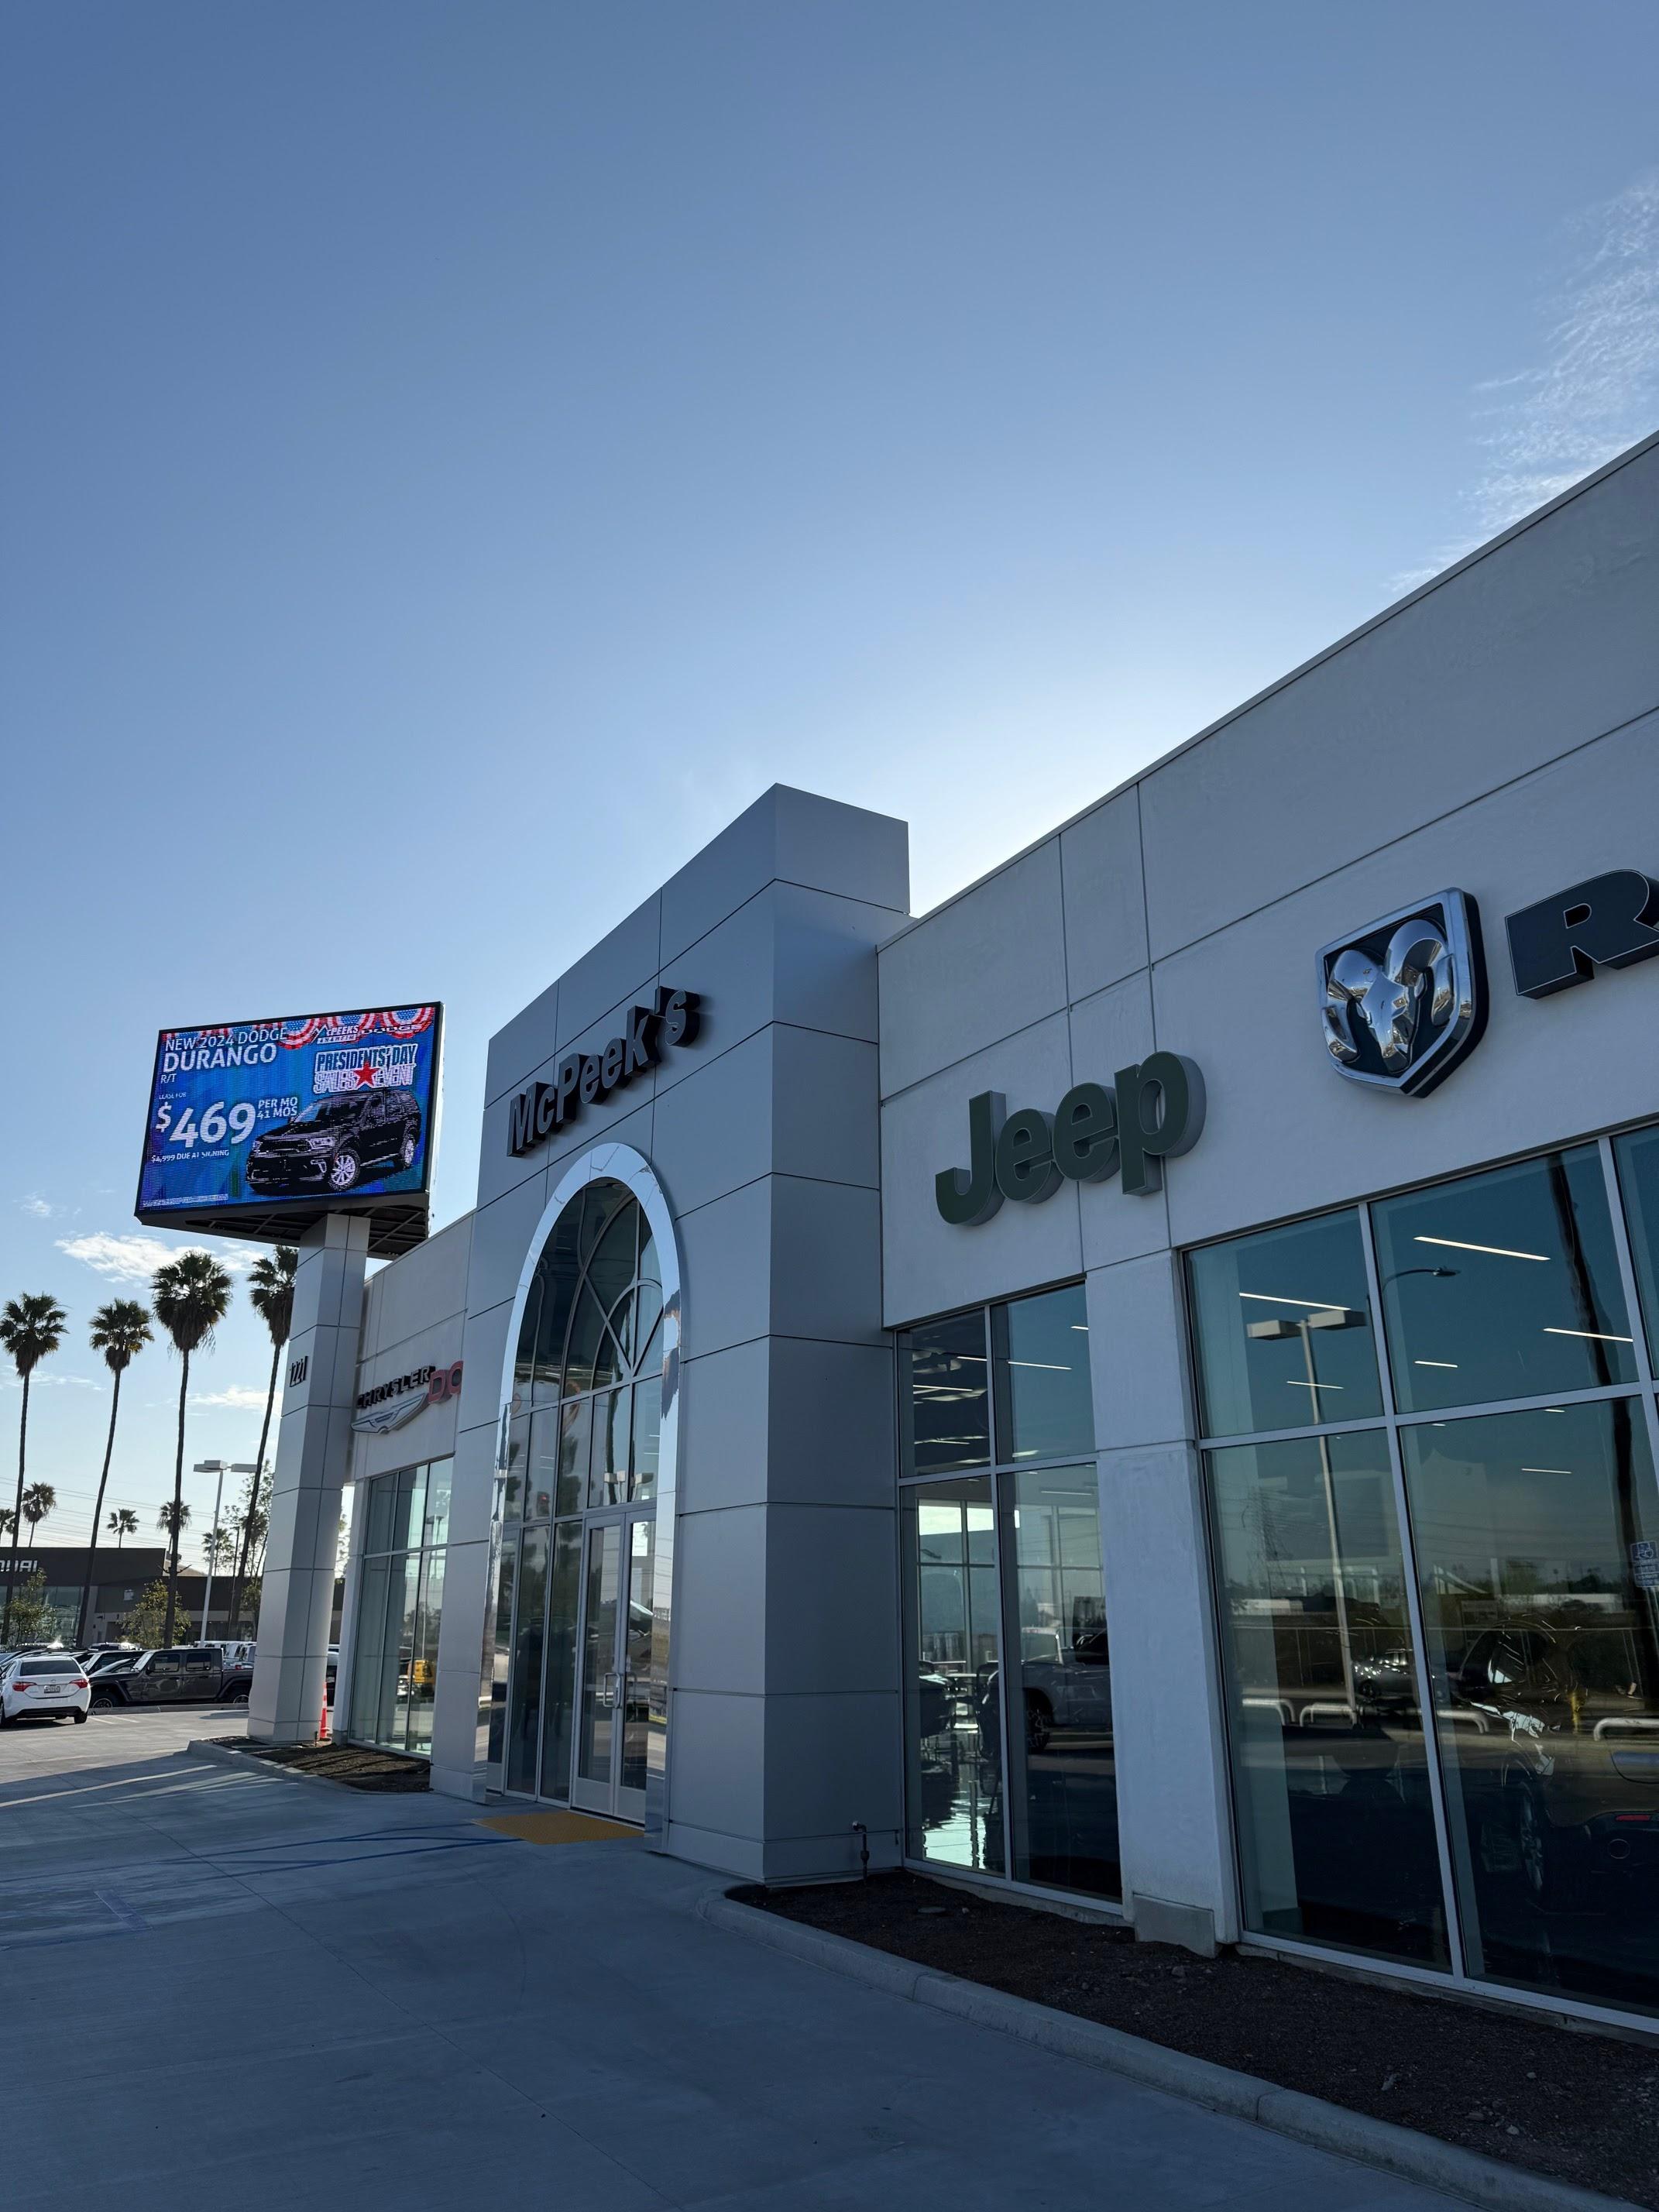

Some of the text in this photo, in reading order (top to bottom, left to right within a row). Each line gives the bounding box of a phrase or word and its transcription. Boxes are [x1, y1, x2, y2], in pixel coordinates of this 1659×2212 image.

[165, 1027, 287, 1052] NEW 2024 DODGE
[163, 1042, 277, 1073] DURANGO
[391, 1045, 417, 1066] DAY
[160, 1073, 177, 1084] R/T
[313, 1064, 417, 1094] SALES EVENT
[507, 986, 700, 1157] McPeek's
[256, 1106, 298, 1120] 41 MOS
[257, 1097, 298, 1109] PER MO
[935, 1050, 1207, 1226] Jeep
[176, 1152, 191, 1160] DUE
[356, 1365, 436, 1409] CHRYSLER
